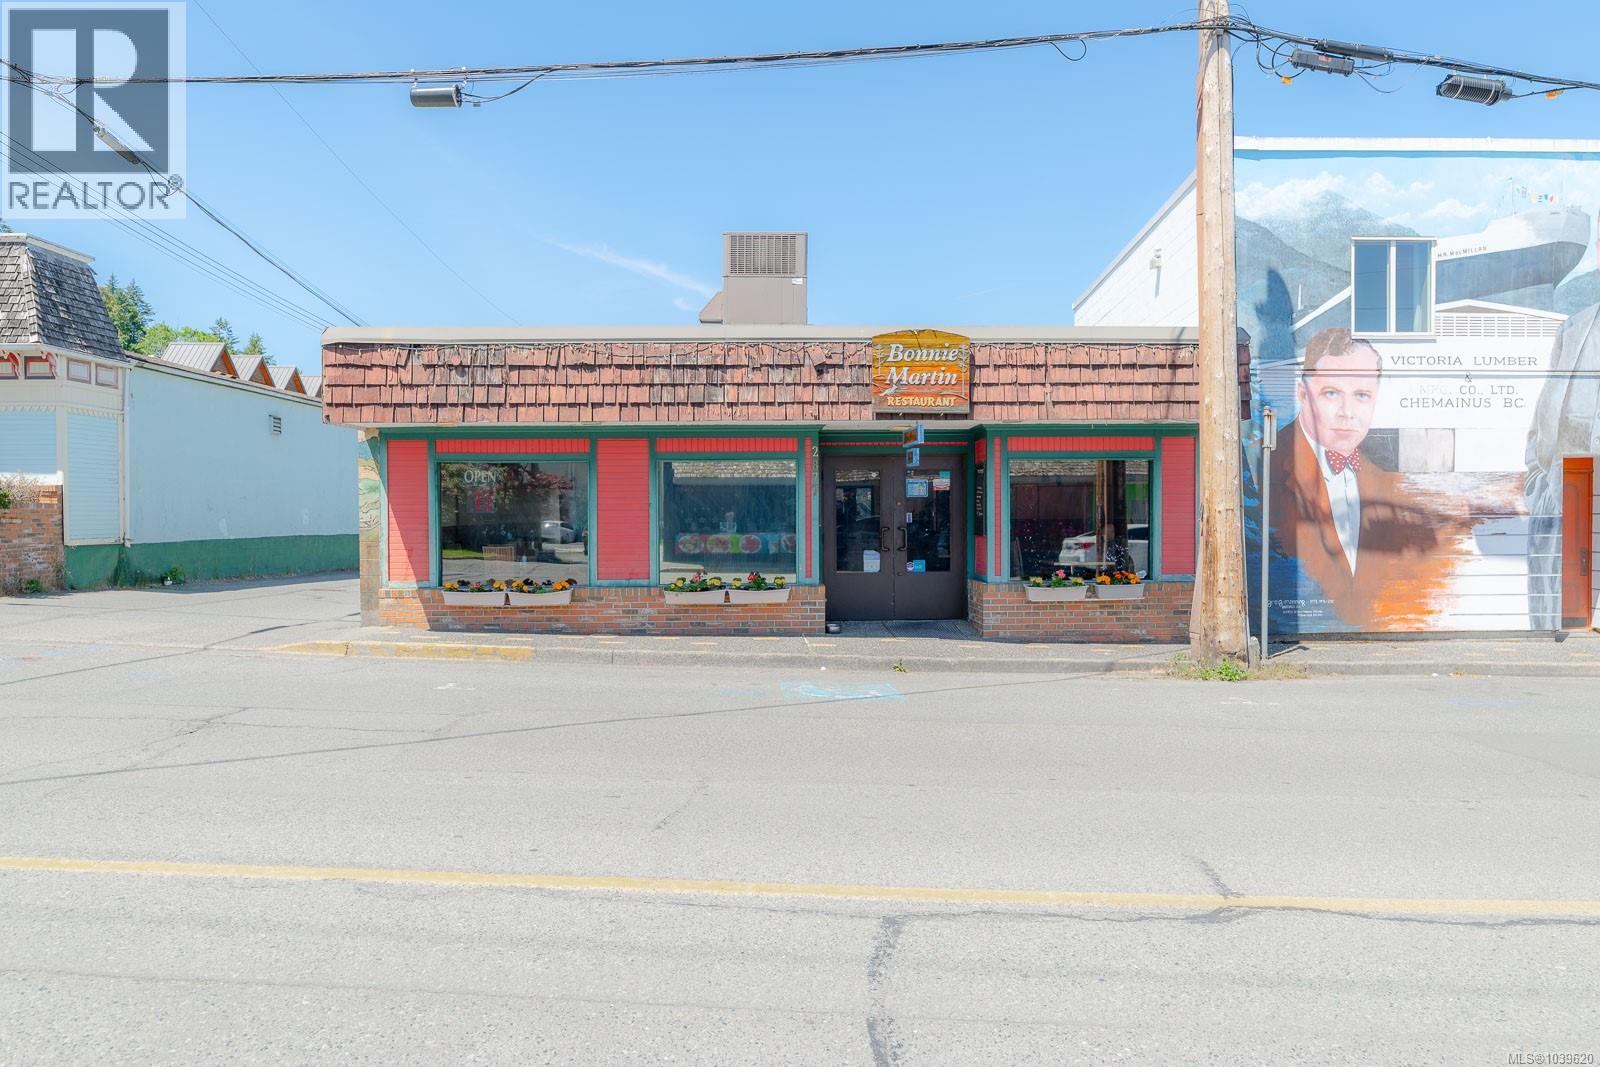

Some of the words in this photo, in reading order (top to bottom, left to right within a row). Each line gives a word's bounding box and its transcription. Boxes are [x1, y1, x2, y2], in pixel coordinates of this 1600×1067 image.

[886, 343, 959, 362] Bonnie
[1390, 355, 1463, 366] VICTORIA
[1473, 356, 1538, 366] LUMBER
[885, 366, 958, 385] Martin
[1464, 373, 1473, 383] &
[886, 396, 957, 406] RESTAURANT
[1399, 397, 1492, 408] CHEMAINUS
[464, 470, 496, 483] OPEN
